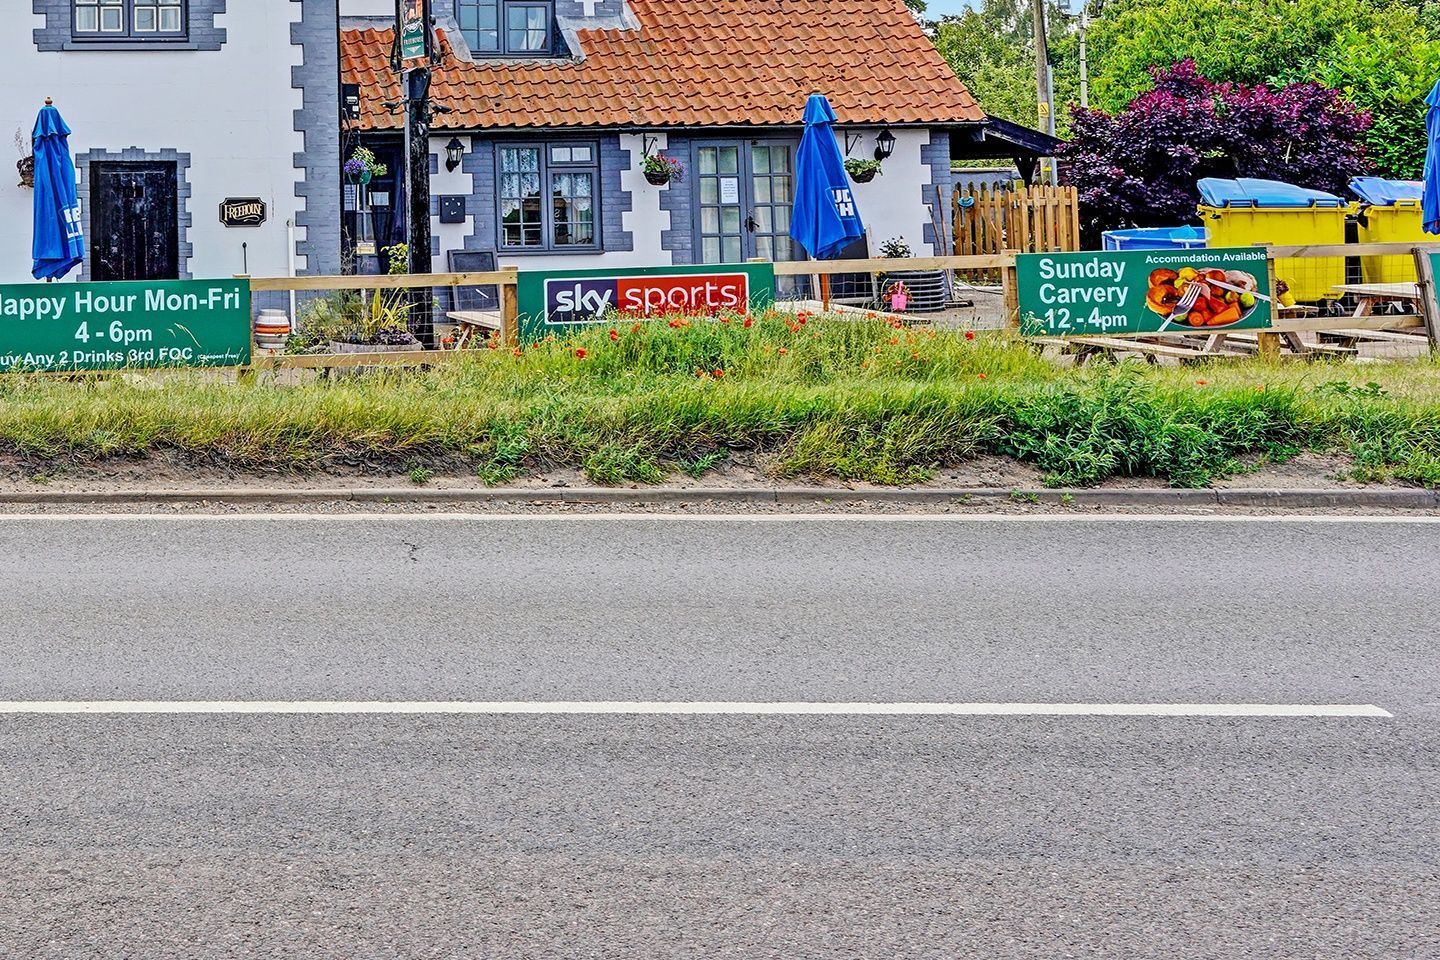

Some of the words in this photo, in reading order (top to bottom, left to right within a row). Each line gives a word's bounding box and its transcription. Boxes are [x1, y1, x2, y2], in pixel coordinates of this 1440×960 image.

[1145, 253, 1221, 264] Accommdation
[1222, 251, 1266, 262] Available
[1039, 257, 1126, 283] Sunday
[75, 290, 137, 313] Hour
[145, 288, 240, 312] Mon-Fri
[556, 284, 613, 317] sky
[625, 282, 738, 315] sports
[1039, 283, 1129, 307] Carvery
[24, 352, 55, 368] Any
[59, 350, 69, 363] 2
[73, 349, 124, 363] Drinks
[129, 348, 154, 361] 3rd
[159, 347, 193, 360] FOC
